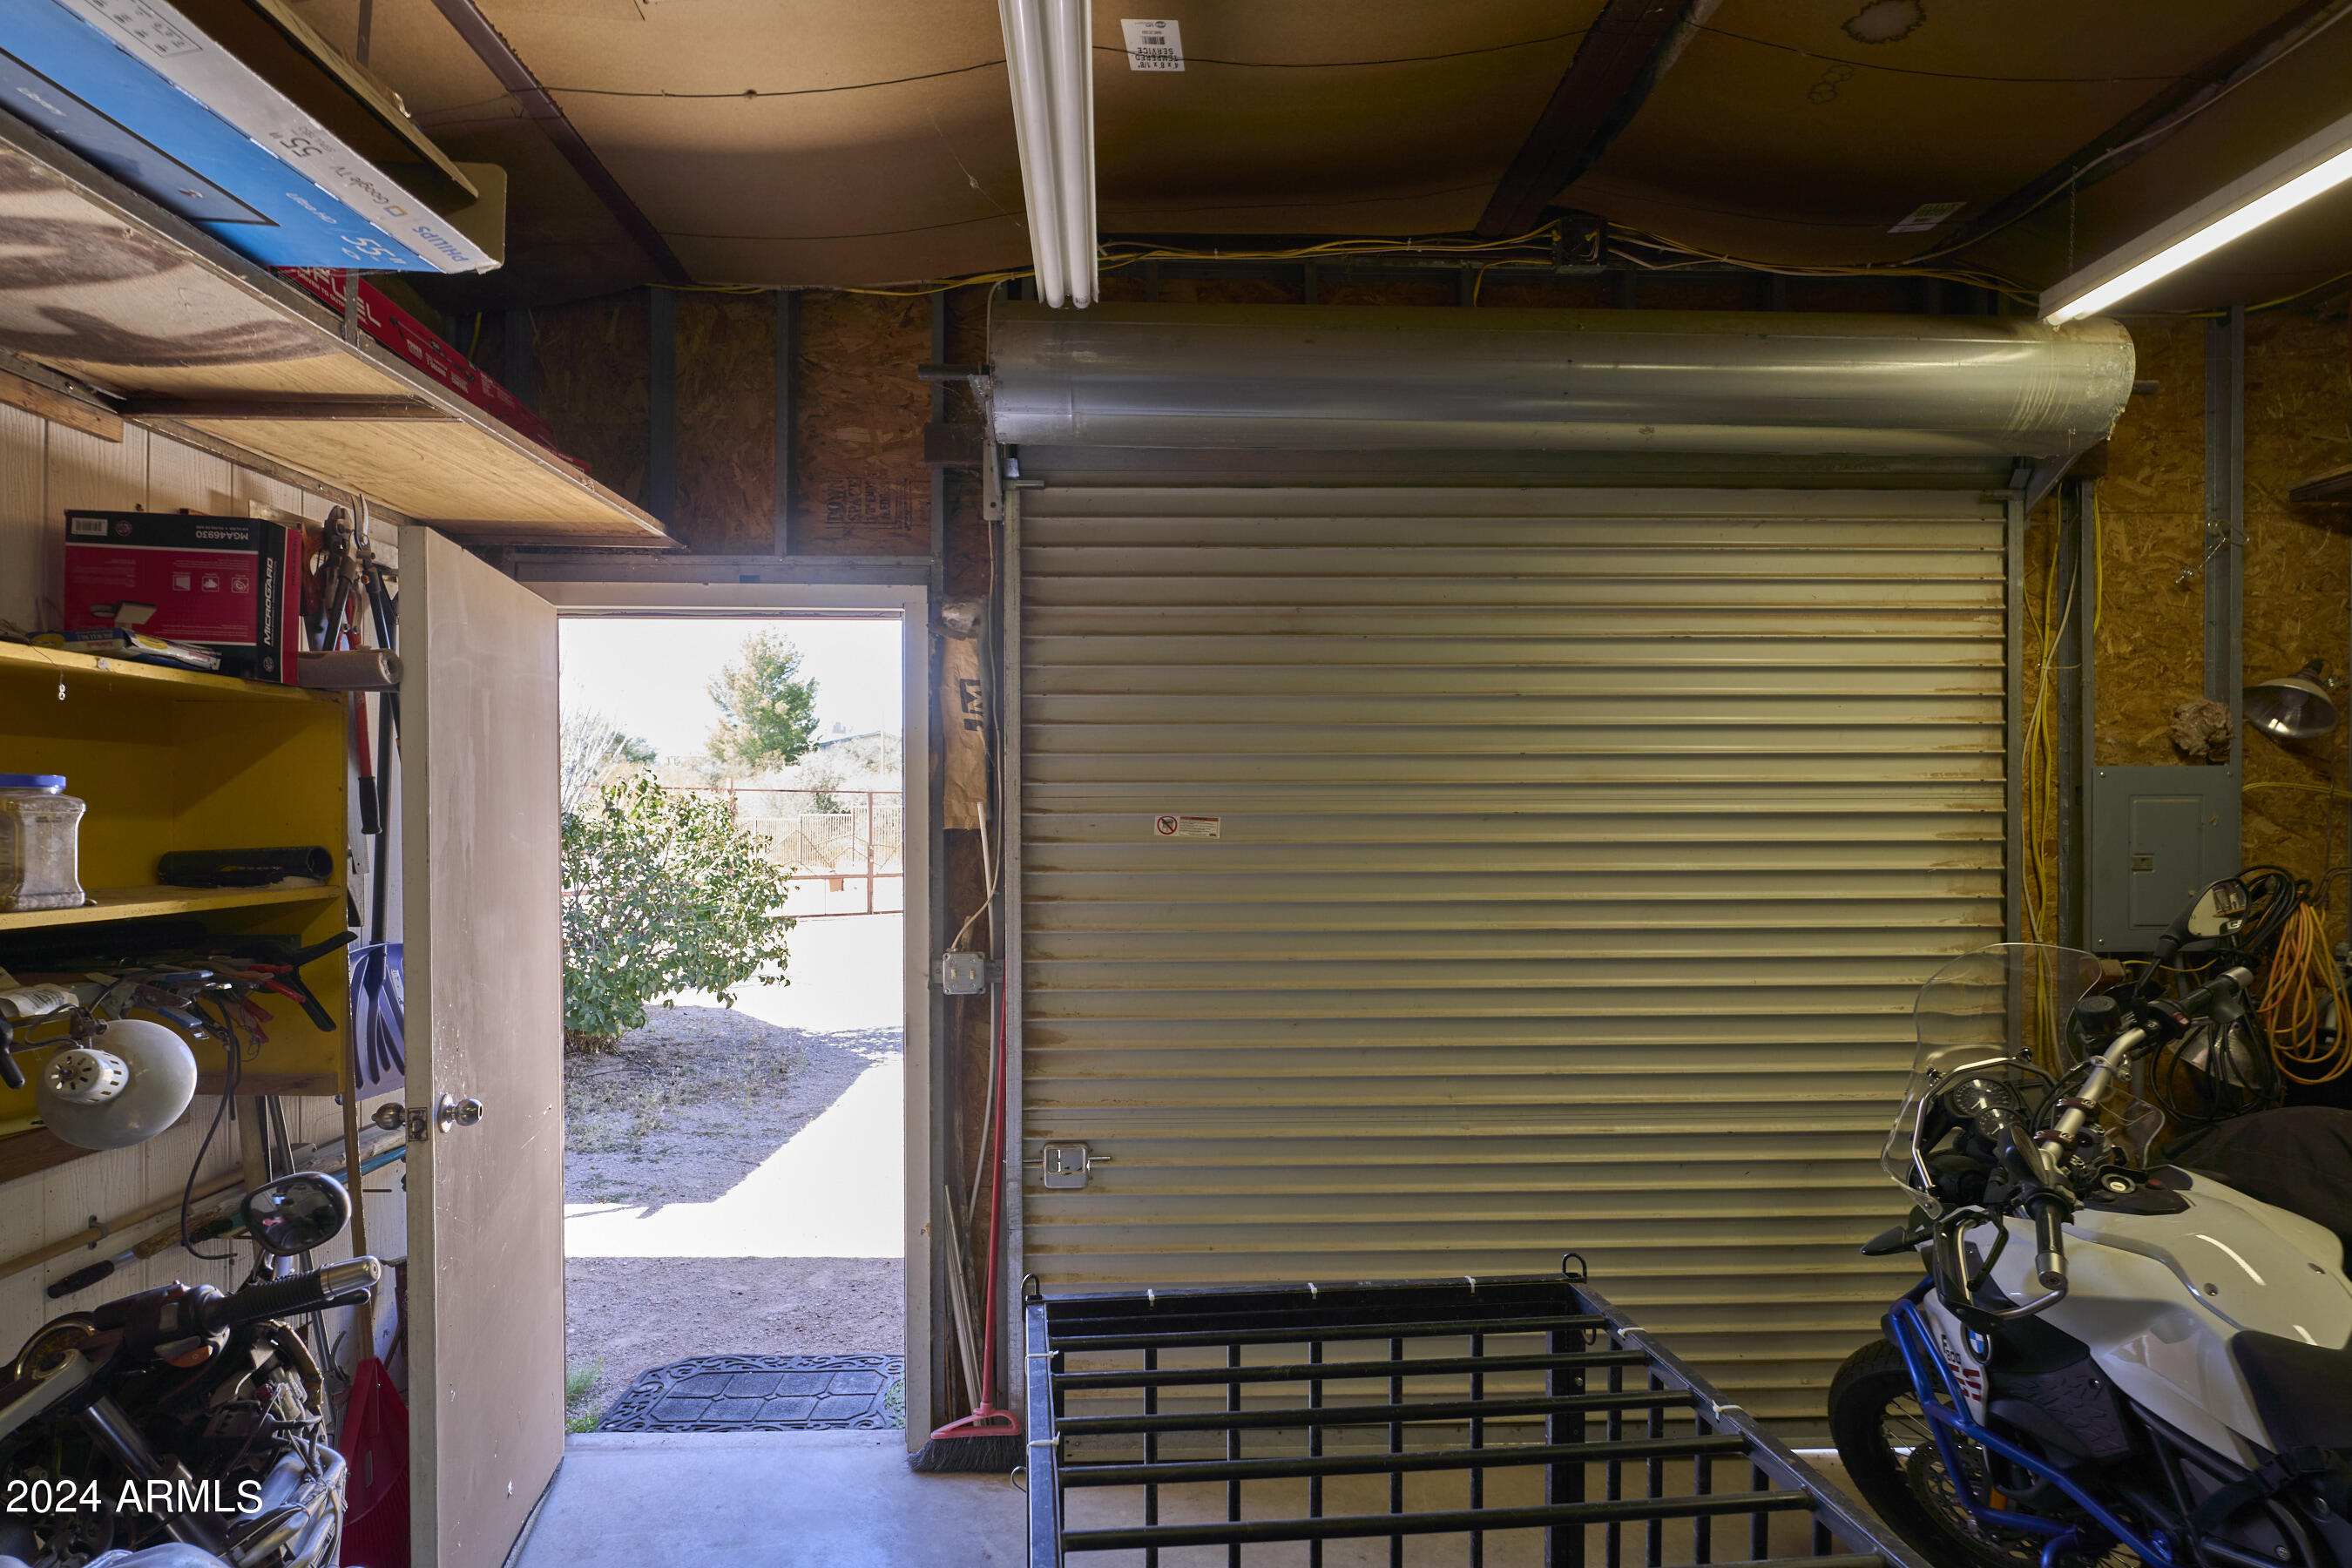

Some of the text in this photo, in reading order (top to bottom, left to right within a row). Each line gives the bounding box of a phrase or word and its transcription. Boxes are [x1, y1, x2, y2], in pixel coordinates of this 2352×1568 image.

[328, 165, 390, 205] Google TV
[411, 225, 470, 263] PHILIPS
[195, 530, 249, 540] MGA46930
